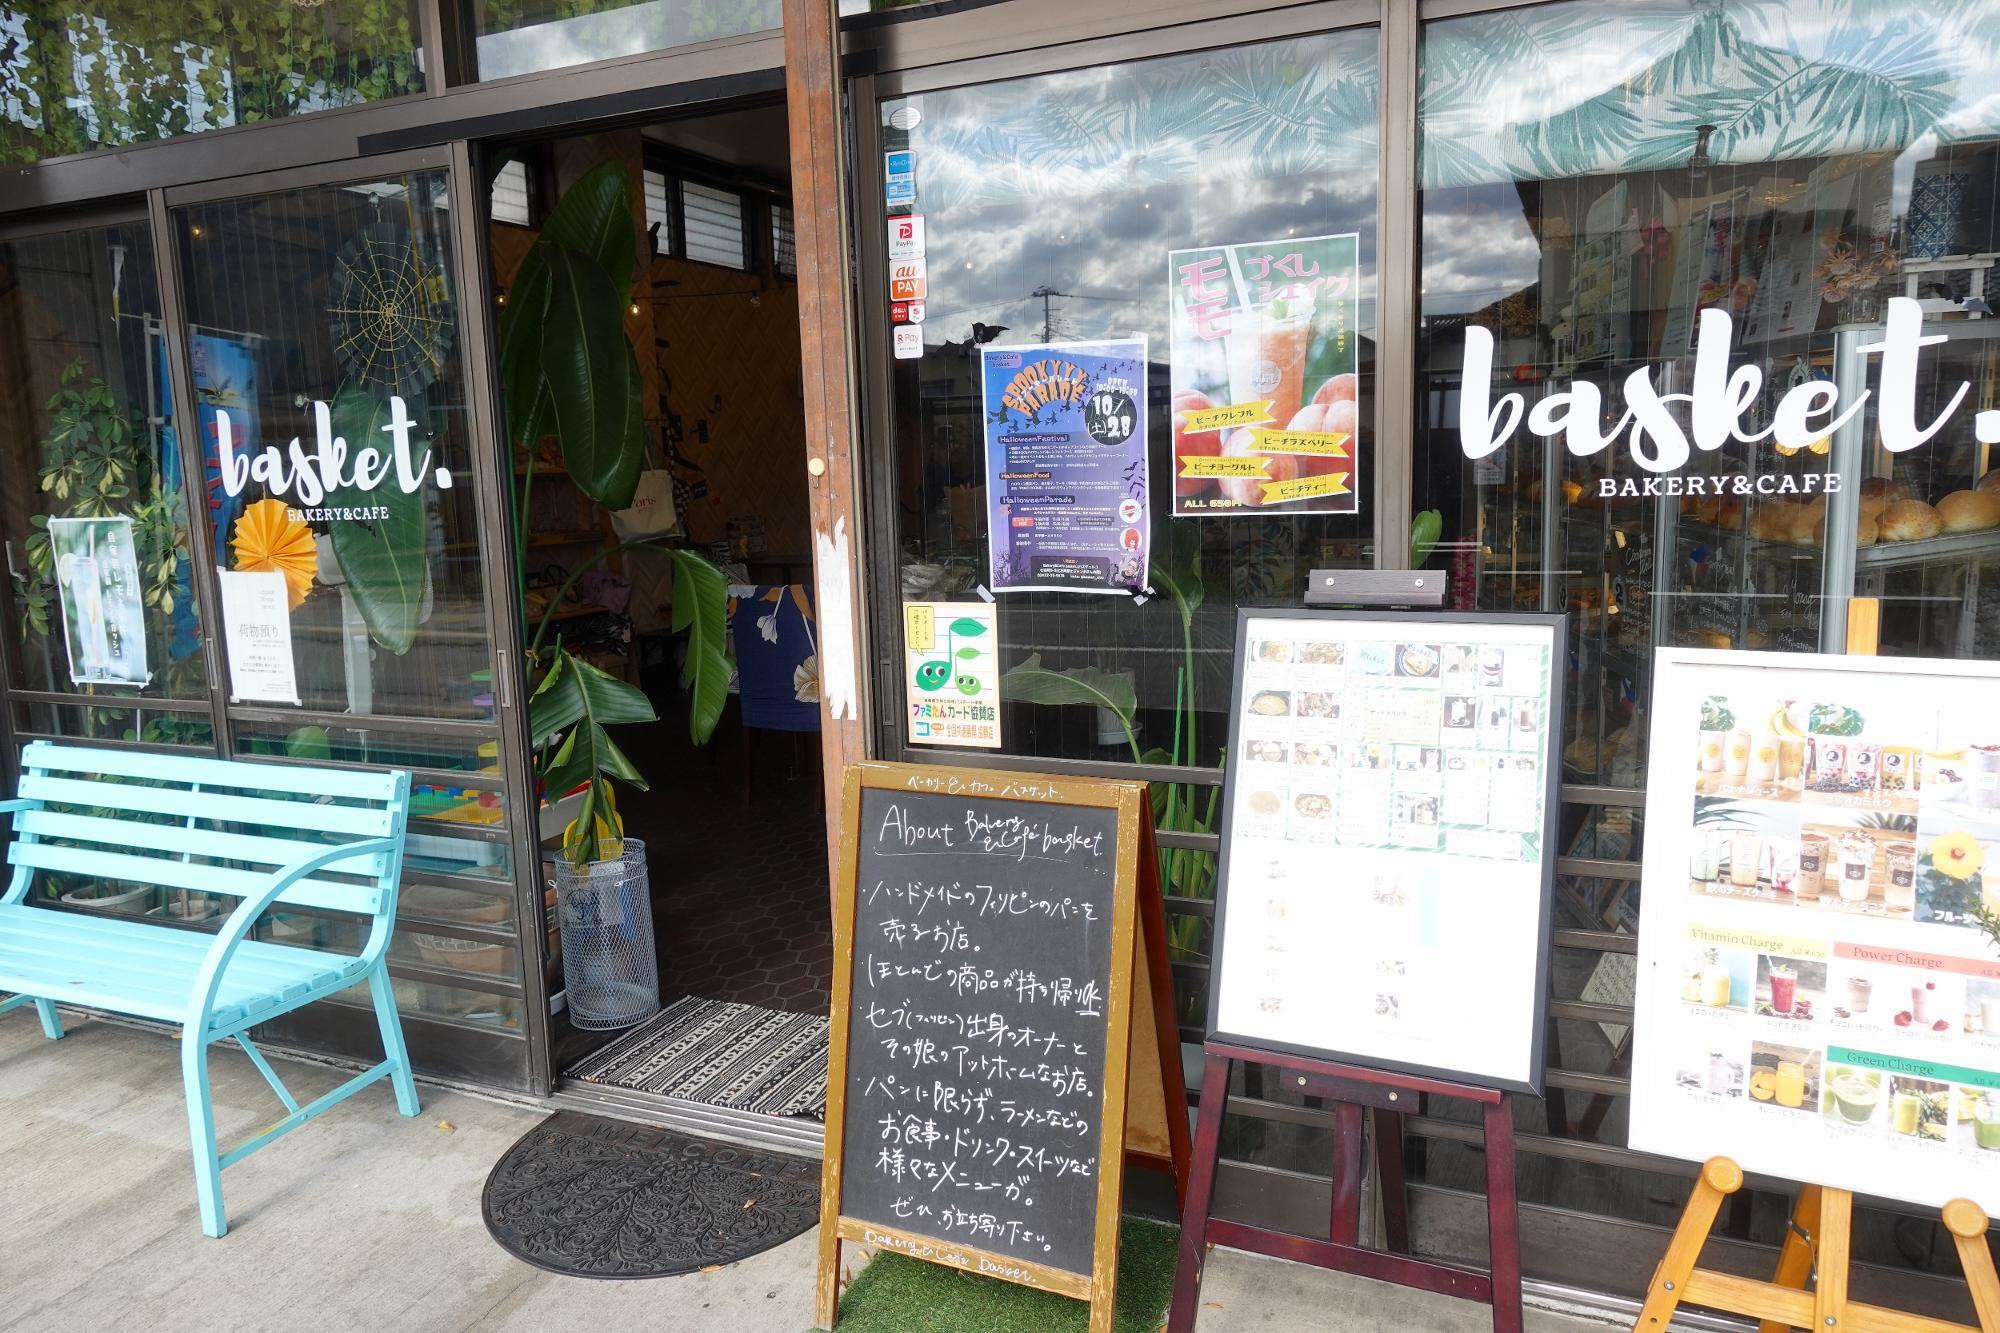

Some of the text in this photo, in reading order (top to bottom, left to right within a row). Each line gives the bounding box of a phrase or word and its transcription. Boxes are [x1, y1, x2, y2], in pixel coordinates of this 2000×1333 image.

[896, 240, 917, 248] PayPay
[896, 265, 919, 278] au
[1245, 254, 1320, 280] づくし
[898, 281, 919, 293] PAY
[1258, 276, 1349, 302] シェイク
[1460, 296, 2000, 473] basket.
[215, 396, 452, 506] basket.
[1599, 474, 1842, 497] BAKERY&CAFE
[287, 506, 390, 522] BAKERY&CAFE
[1184, 499, 1207, 508] ALL
[880, 804, 954, 847] About
[879, 918, 981, 953] 売るお店。
[1691, 928, 1784, 951] Vitamin Charge
[1853, 947, 1944, 969] Power Charge
[1847, 1052, 1934, 1076] Green Charge
